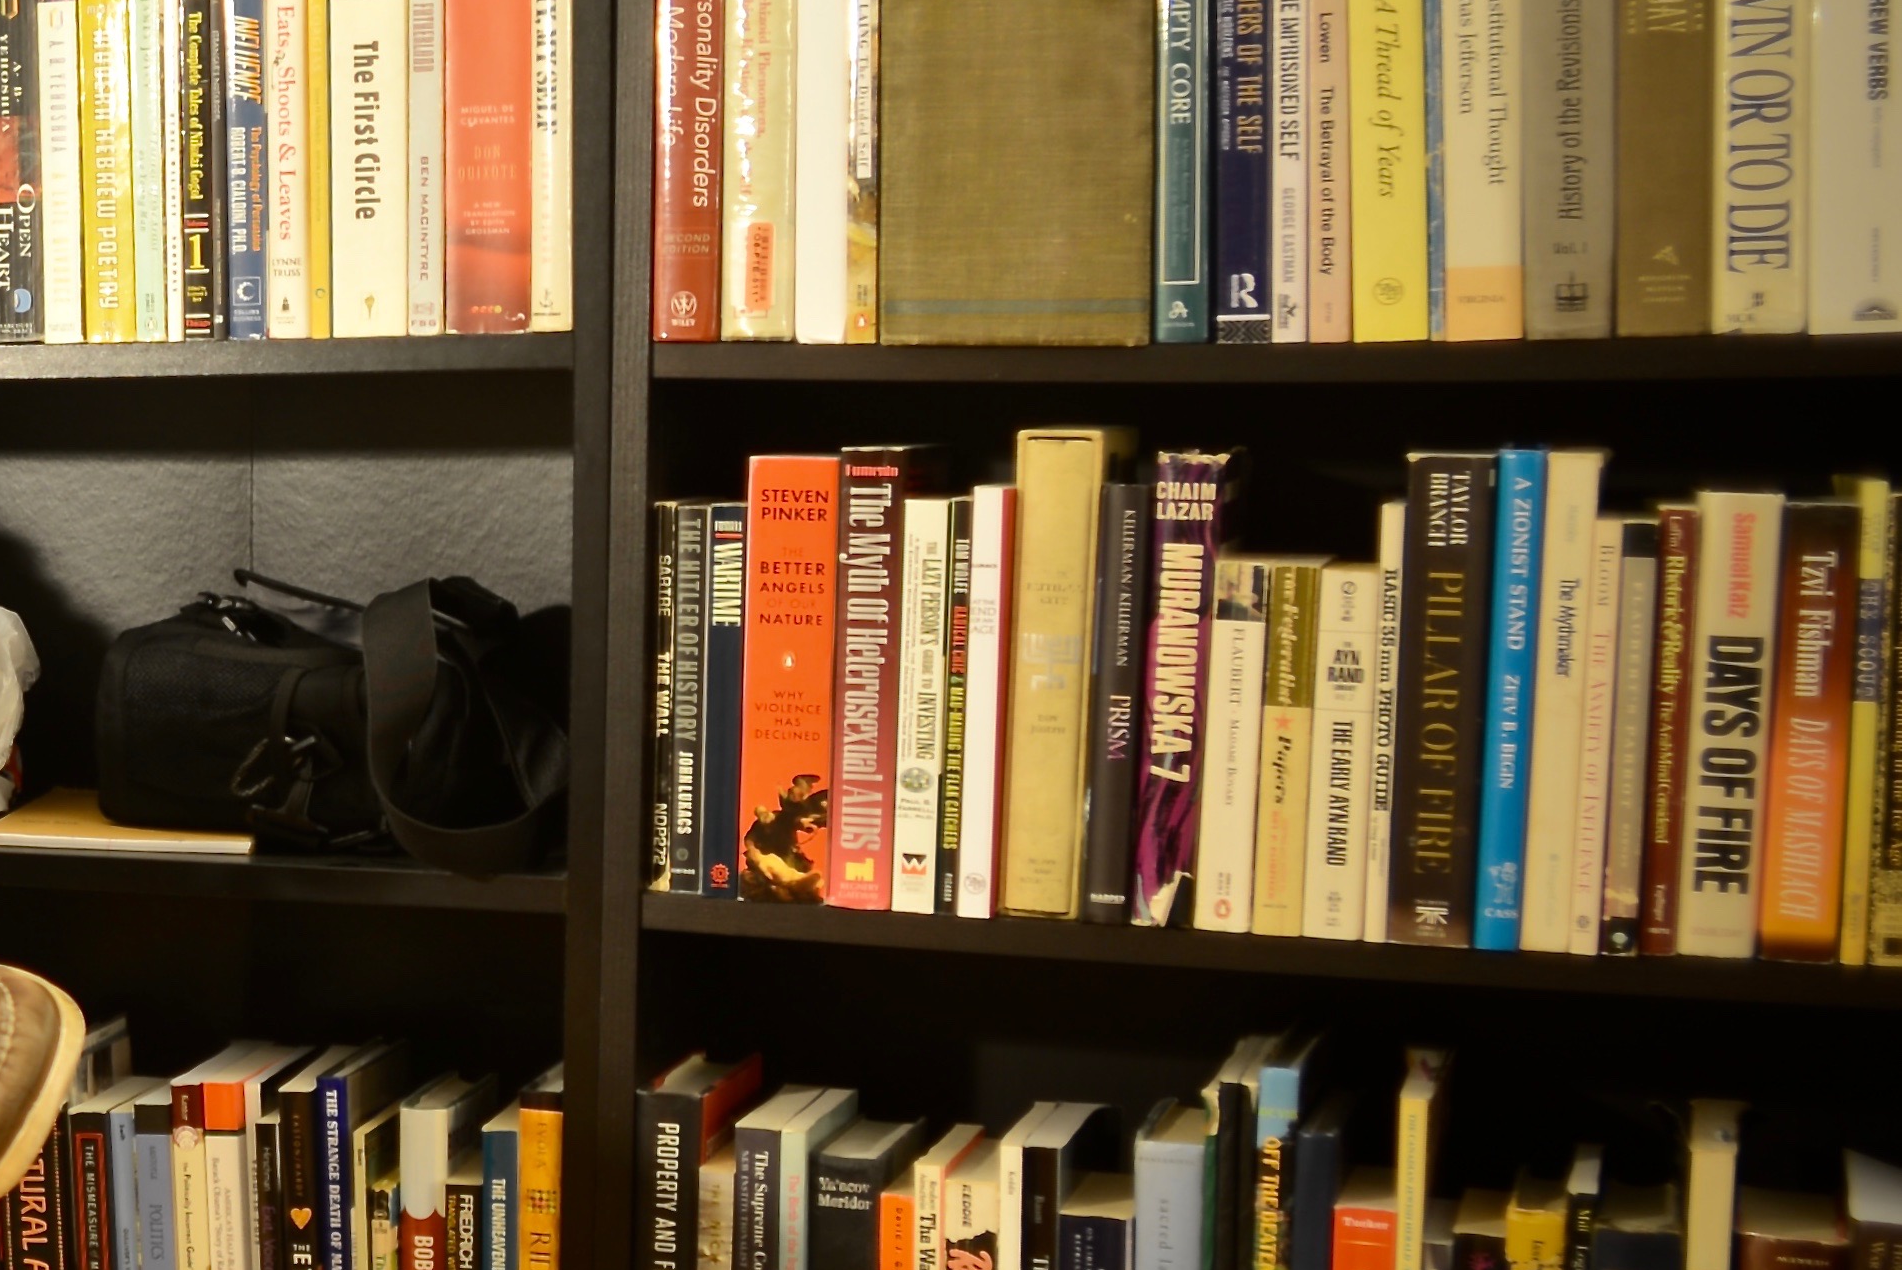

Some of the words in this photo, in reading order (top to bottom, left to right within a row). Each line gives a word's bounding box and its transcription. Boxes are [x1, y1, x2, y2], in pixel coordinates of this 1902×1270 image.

[353, 41, 378, 82] The
[354, 92, 378, 144] First
[1170, 64, 1191, 125] CORE
[1729, 70, 1792, 129] OR
[693, 96, 717, 208] Disorders
[1727, 135, 1791, 191] TO
[354, 149, 380, 220] Circle
[1725, 205, 1790, 273] DIE
[761, 489, 829, 504] STEVEN
[761, 507, 827, 522] PINKER
[1157, 482, 1216, 501] CHAIM
[1157, 502, 1213, 521] LAZAR
[760, 562, 826, 576] BETTER
[760, 581, 825, 594] ANGELS
[759, 614, 823, 626] NATURE
[1150, 542, 1204, 755] MURANOWSKA
[1703, 636, 1763, 737] DAYS
[1151, 765, 1190, 782] 7
[1700, 748, 1756, 798] OF
[1694, 806, 1755, 894] FIRE
[657, 1122, 679, 1211] PROPERTY
[655, 1216, 676, 1252] AND
